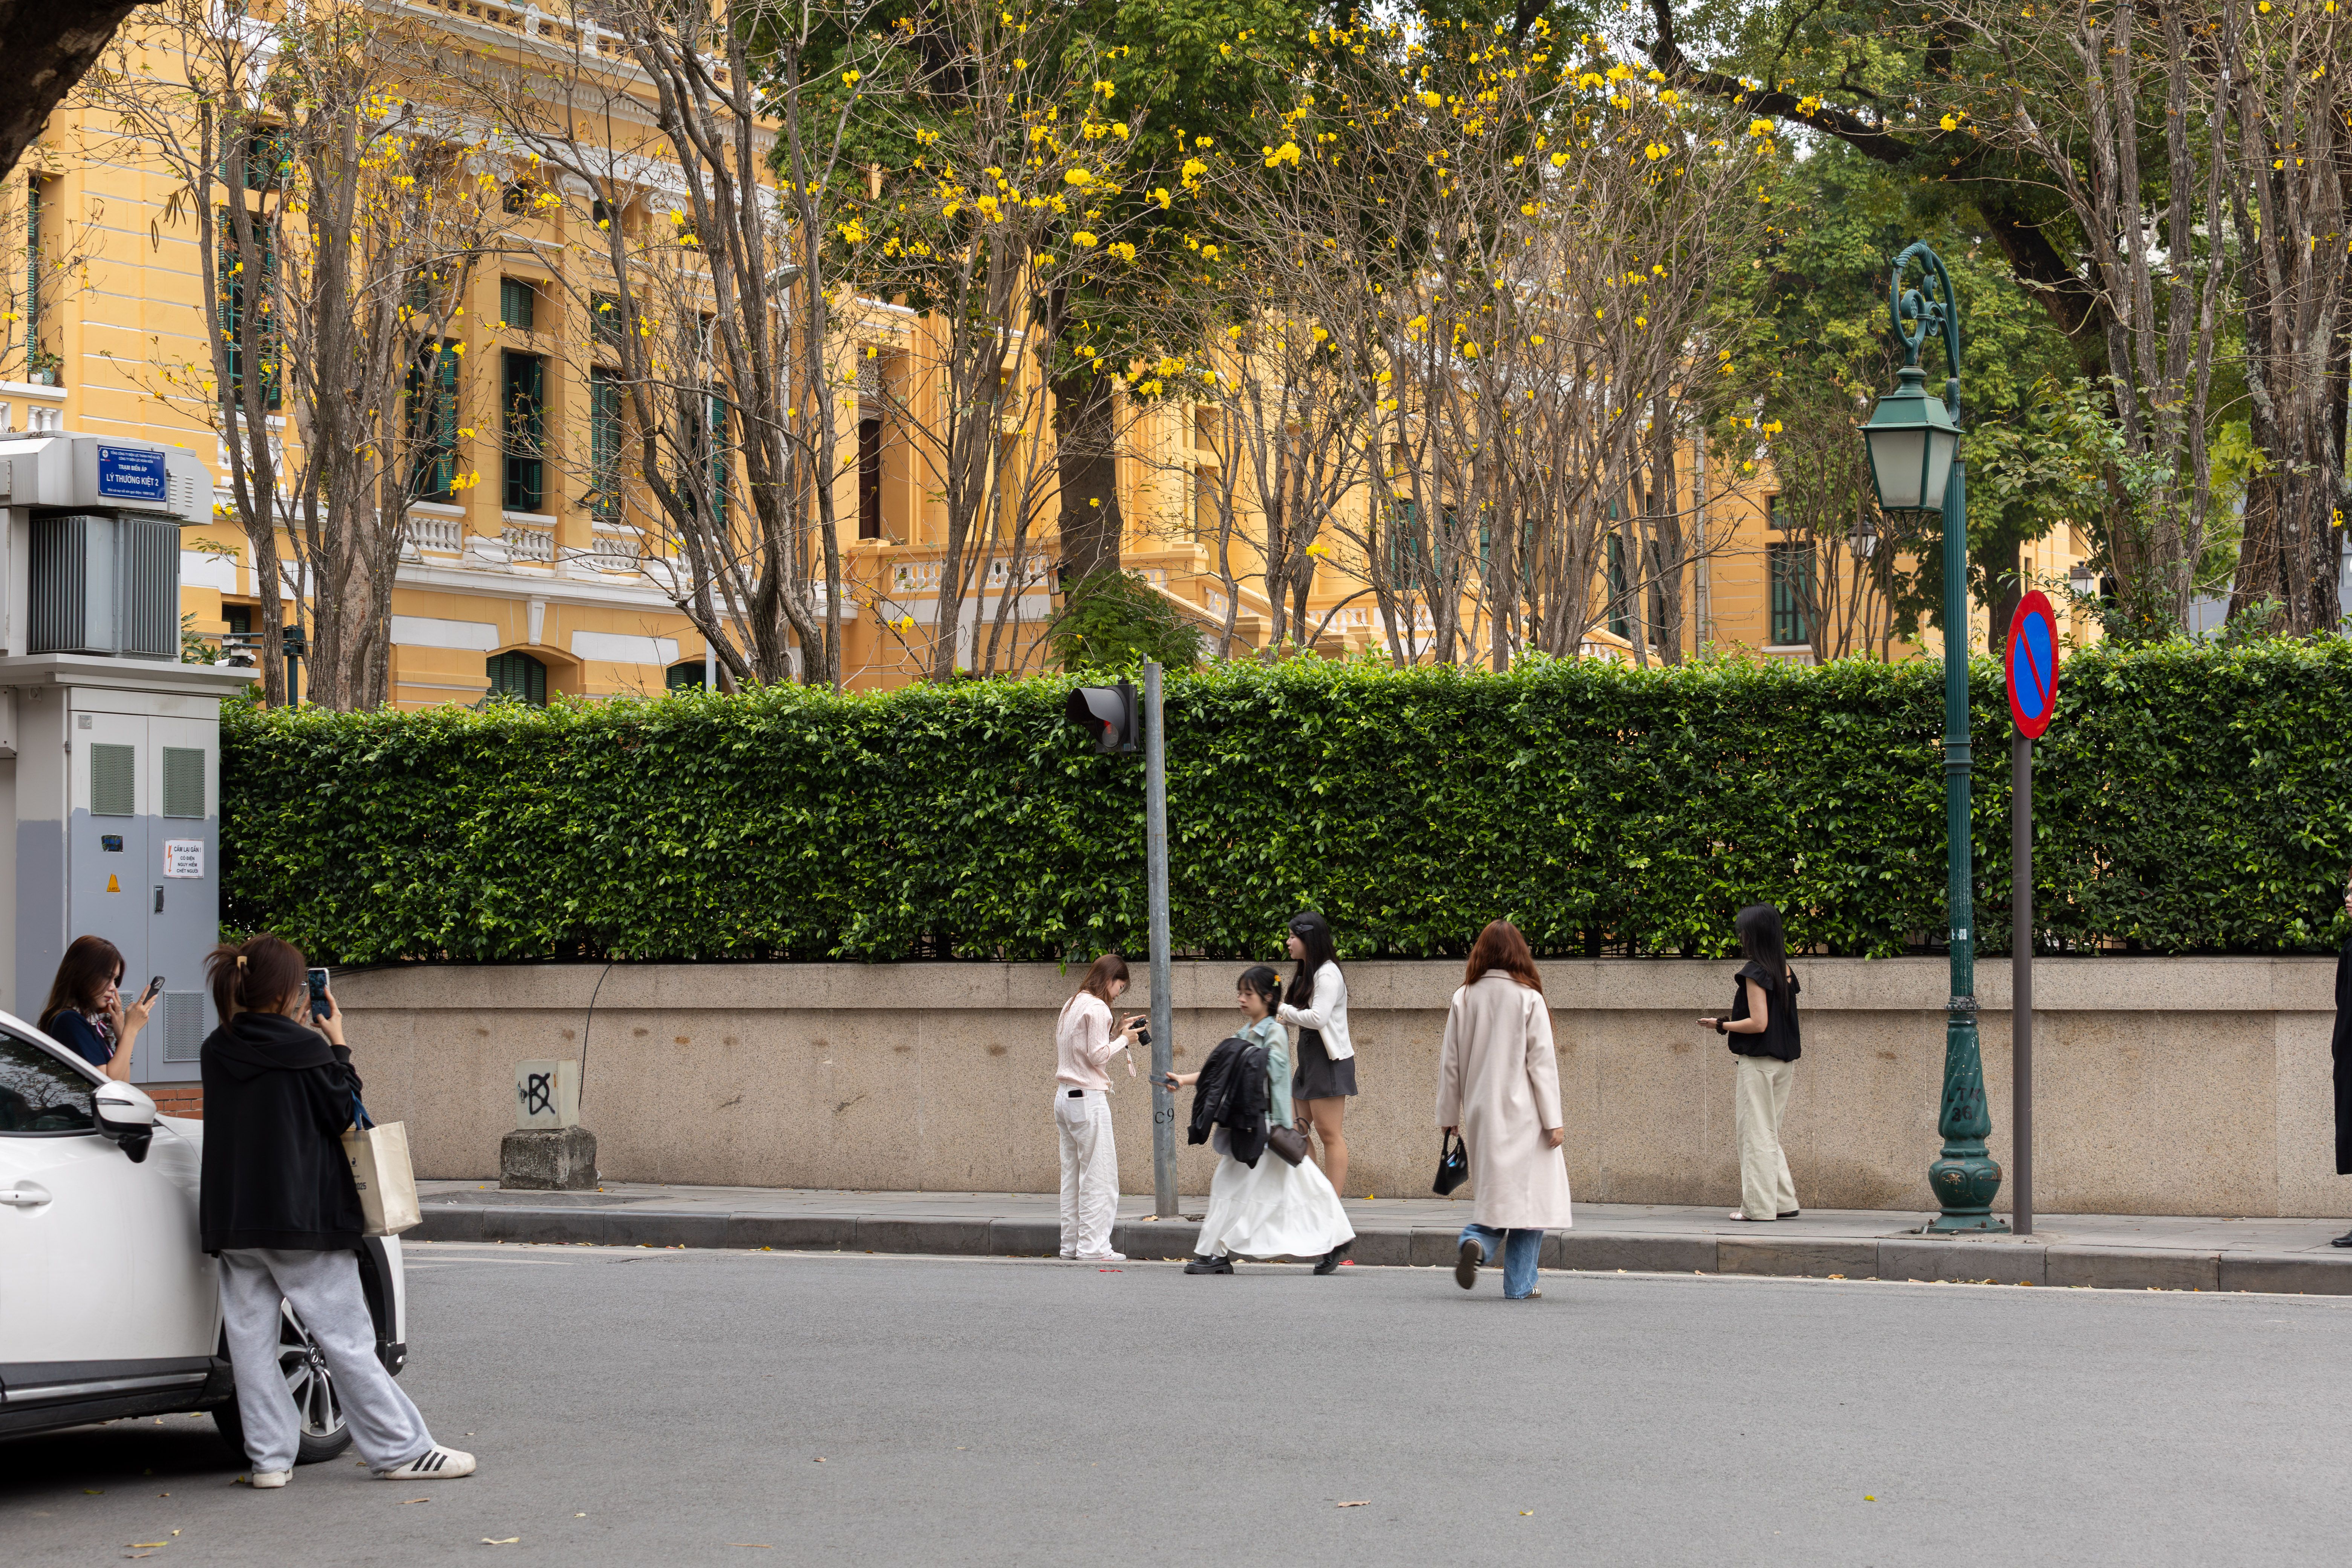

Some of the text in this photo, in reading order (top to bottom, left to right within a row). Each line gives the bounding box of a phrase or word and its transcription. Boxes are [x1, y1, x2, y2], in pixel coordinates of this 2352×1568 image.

[106, 472, 114, 482] LÝ
[115, 473, 140, 484] THƯỜNG
[141, 476, 154, 487] KIỆT
[1947, 1086, 1981, 1103] LTK
